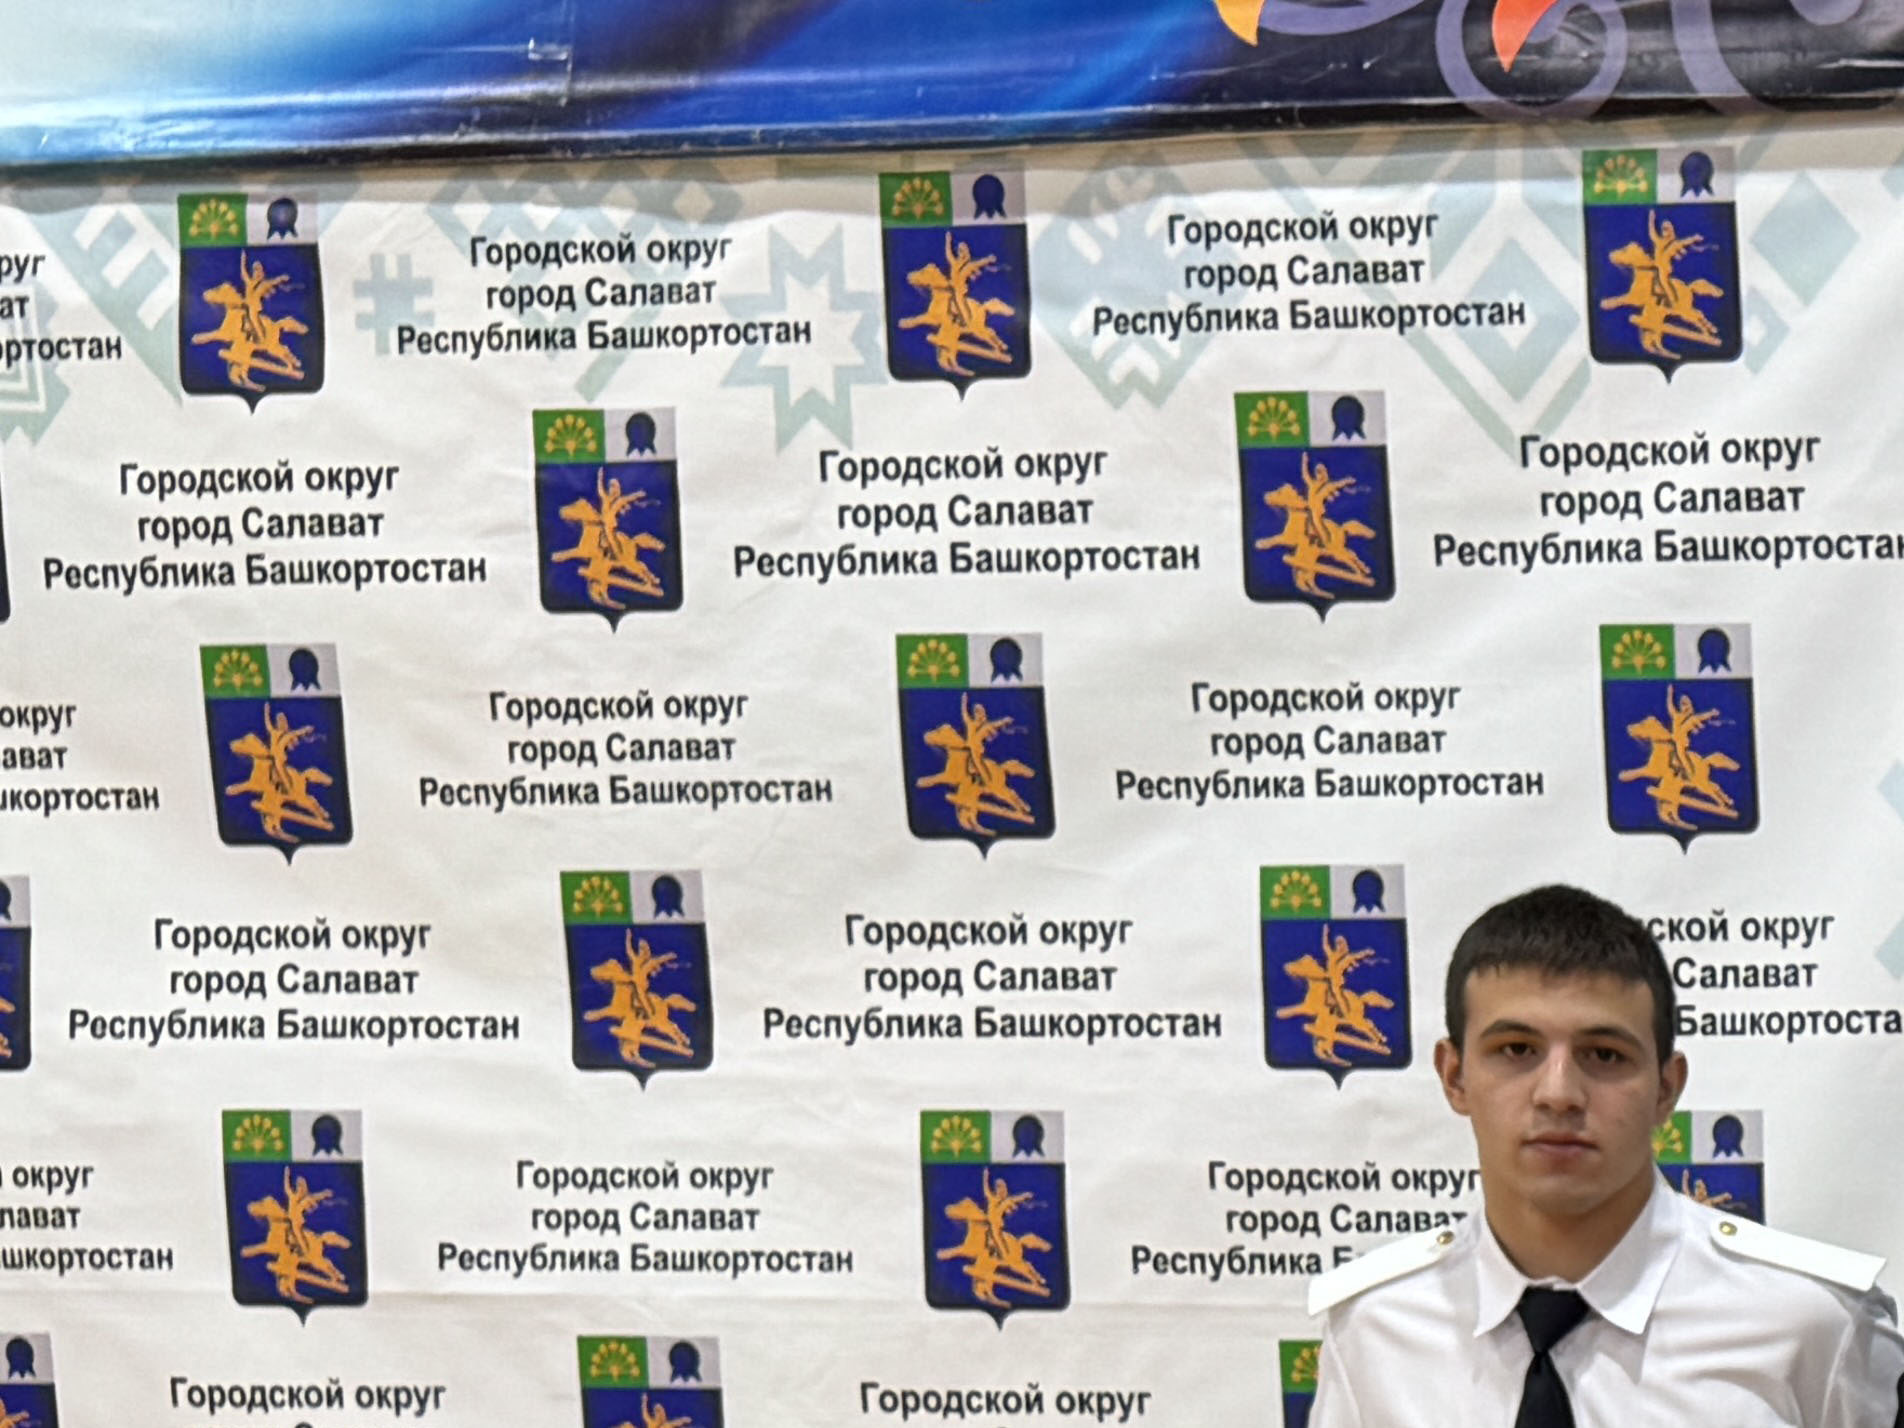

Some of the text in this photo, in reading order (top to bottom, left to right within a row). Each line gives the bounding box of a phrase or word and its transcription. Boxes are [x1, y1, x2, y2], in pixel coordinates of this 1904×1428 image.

[470, 231, 732, 273] Городской округ
[1167, 210, 1439, 253] Городской округ
[1184, 254, 1426, 296] город Салават
[486, 276, 717, 316] город Салават
[397, 319, 812, 361] Республика Башкортостан
[1093, 298, 1526, 342] Республика Башкортостан
[819, 446, 1108, 490] Городской округ
[1519, 431, 1821, 477] Городской округ
[120, 459, 400, 503] Городской округ
[837, 493, 1094, 537] город Салават
[1540, 480, 1806, 525] город Салават
[137, 506, 385, 549] город Салават
[734, 541, 1200, 585] Республика Башкортостан
[1433, 531, 1643, 575] Республика
[43, 552, 487, 597] Республика Башкортостан
[0, 704, 77, 736] округ
[489, 689, 749, 729] Городской округ
[1191, 681, 1461, 721] Городской округ
[508, 731, 737, 771] город Салават
[1210, 724, 1447, 764] город Салават
[419, 774, 833, 814] Республика Башкортостан
[1115, 767, 1544, 807] Республика Башкортостан
[154, 917, 432, 958] Городской округ
[845, 912, 1133, 954] Городской округ
[1740, 915, 1835, 950] округ
[170, 962, 420, 1003] город Салават
[864, 958, 1118, 1000] город Салават
[1672, 956, 1819, 990] Салават
[69, 1008, 520, 1048] Республика Башкортостан
[763, 1005, 1222, 1047] Республика Башкортостан
[12, 1165, 94, 1196] округ
[516, 1159, 774, 1197] Городской округ
[1208, 1160, 1481, 1199] Городской округ
[531, 1201, 761, 1238] город Салават
[1226, 1210, 1322, 1241] город
[438, 1242, 853, 1280] Республика Башкортостан
[1131, 1244, 1323, 1283] Республика
[170, 1376, 446, 1418] Городской округ
[860, 1381, 1152, 1424] Городской округ
